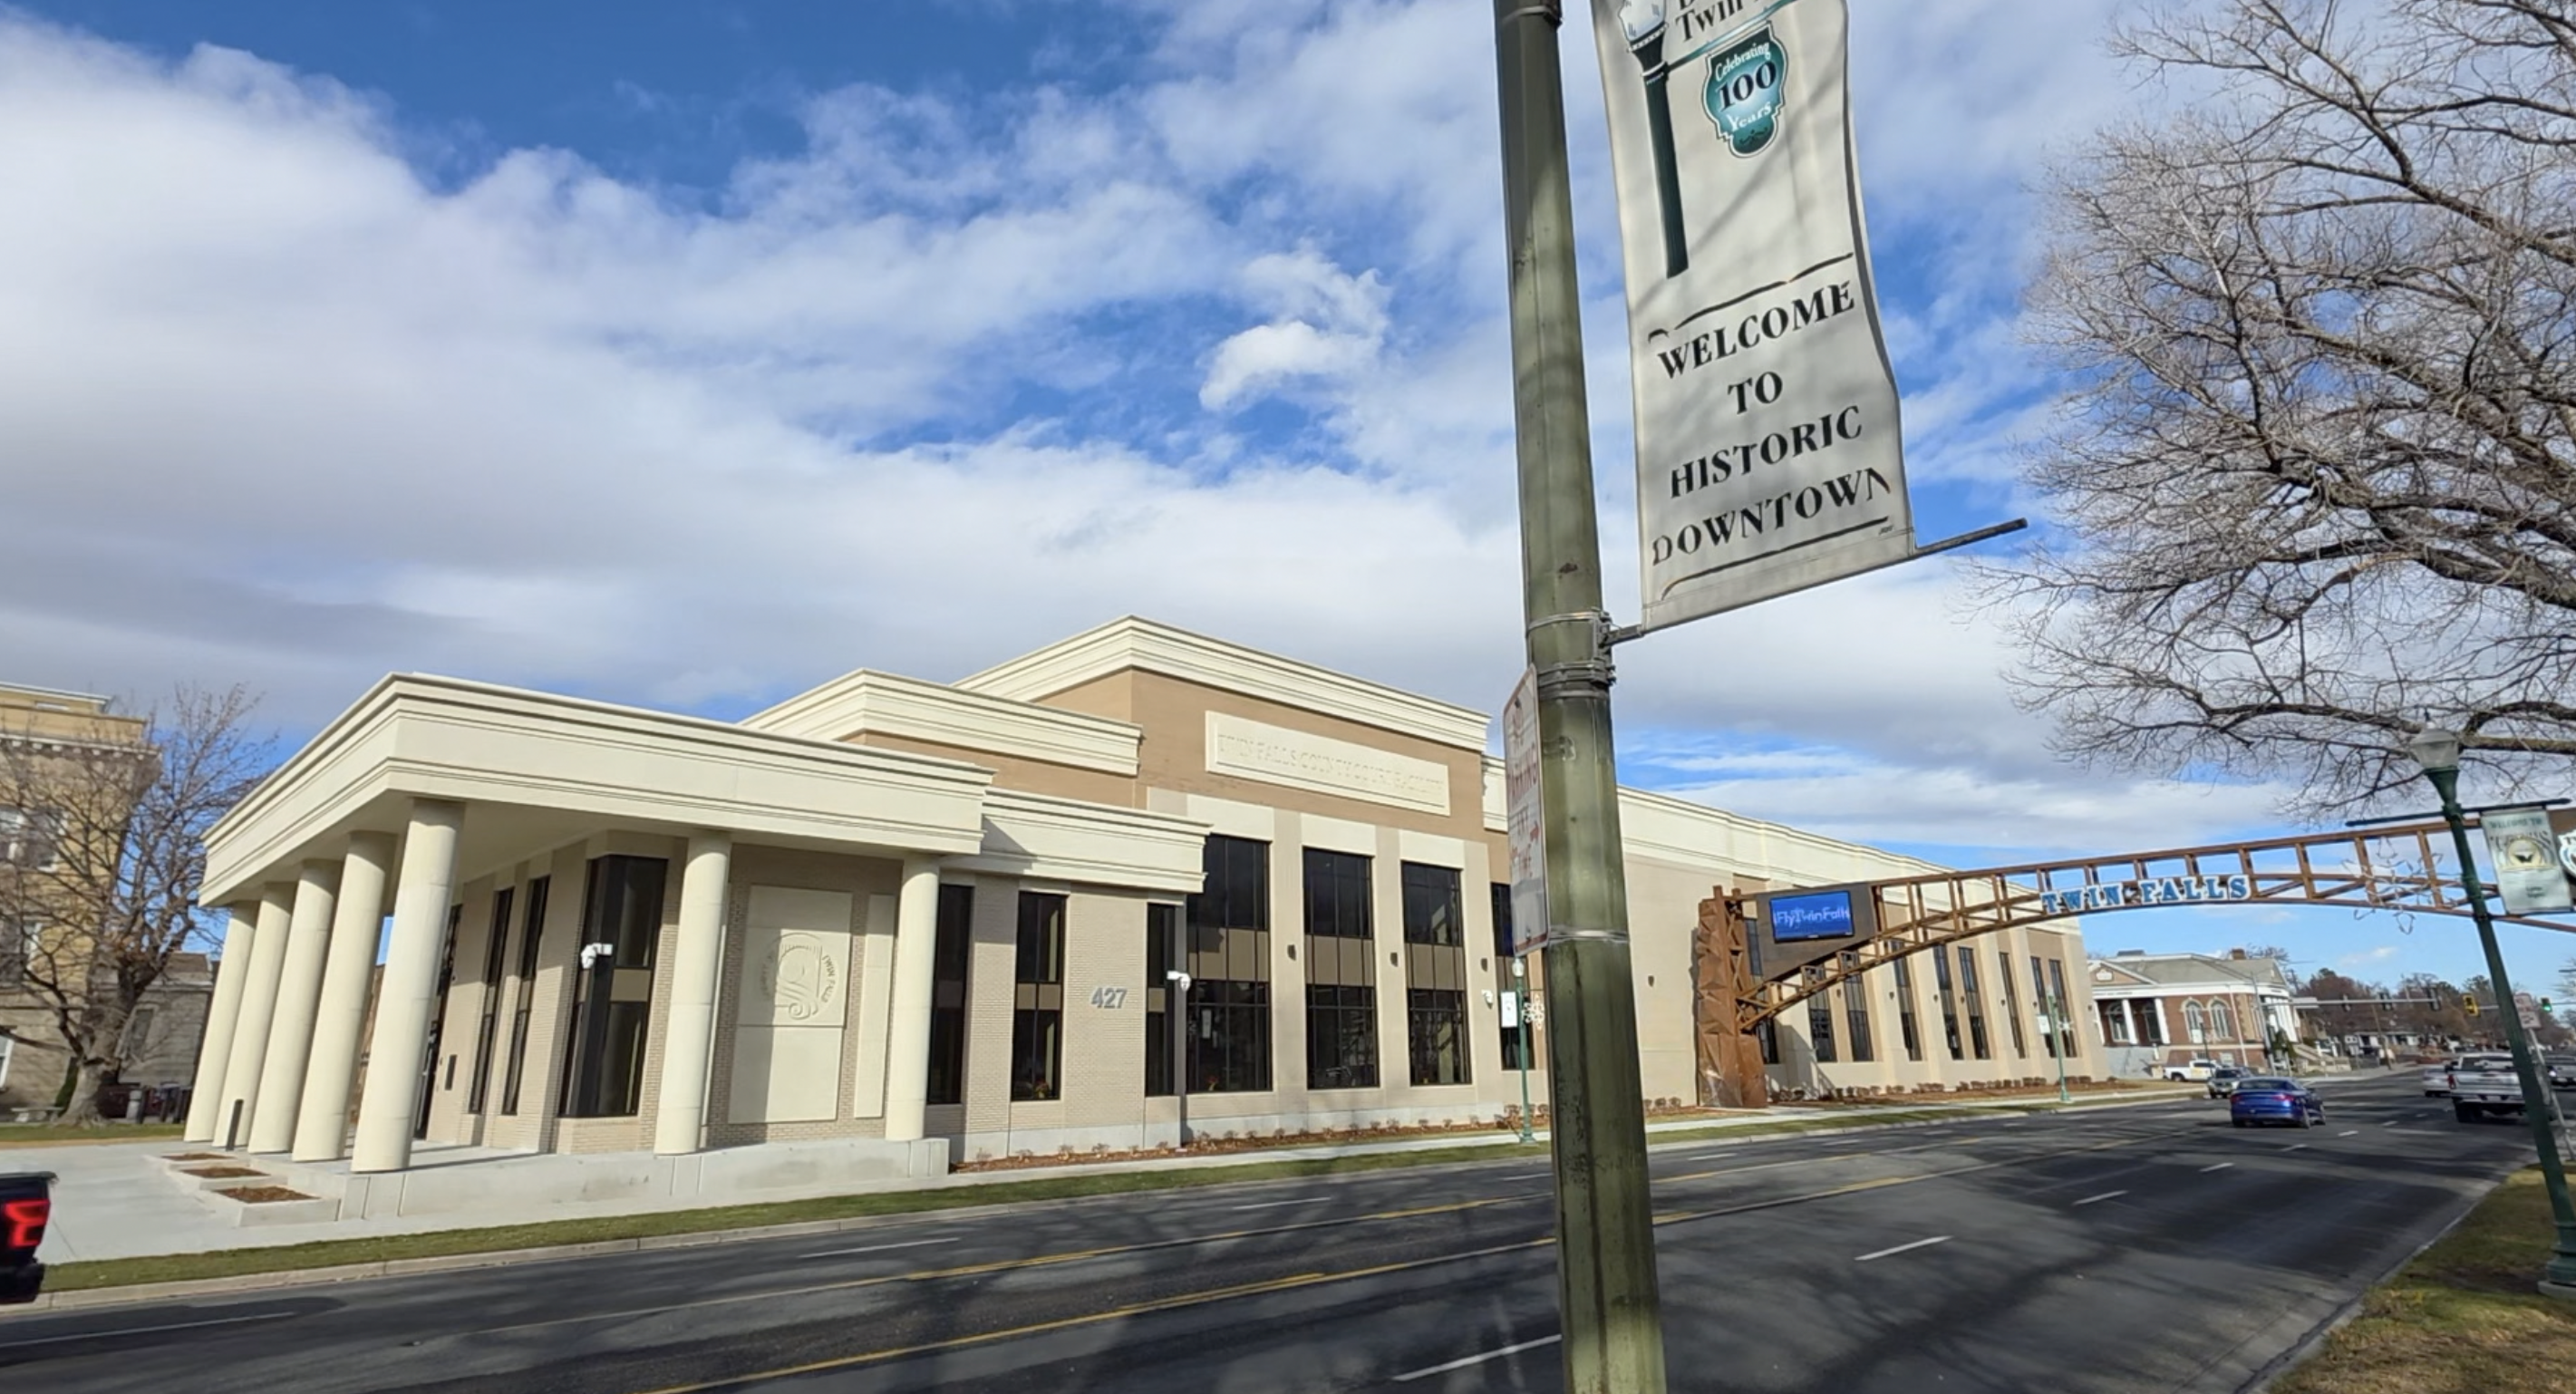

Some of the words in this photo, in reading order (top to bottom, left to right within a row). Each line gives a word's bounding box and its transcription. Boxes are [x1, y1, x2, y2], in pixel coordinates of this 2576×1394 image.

[1715, 42, 1772, 82] Celebrating
[1716, 60, 1777, 112] 100
[1726, 101, 1772, 131] Years
[1657, 280, 1855, 380] WELCOME
[1727, 371, 1783, 415] TO
[1671, 405, 1863, 499] HISTORIC
[1651, 467, 1892, 566] DOWNTOWN
[2041, 883, 2124, 915] TWIN
[2138, 875, 2252, 905] FALLS
[1090, 987, 1128, 1009] 427
